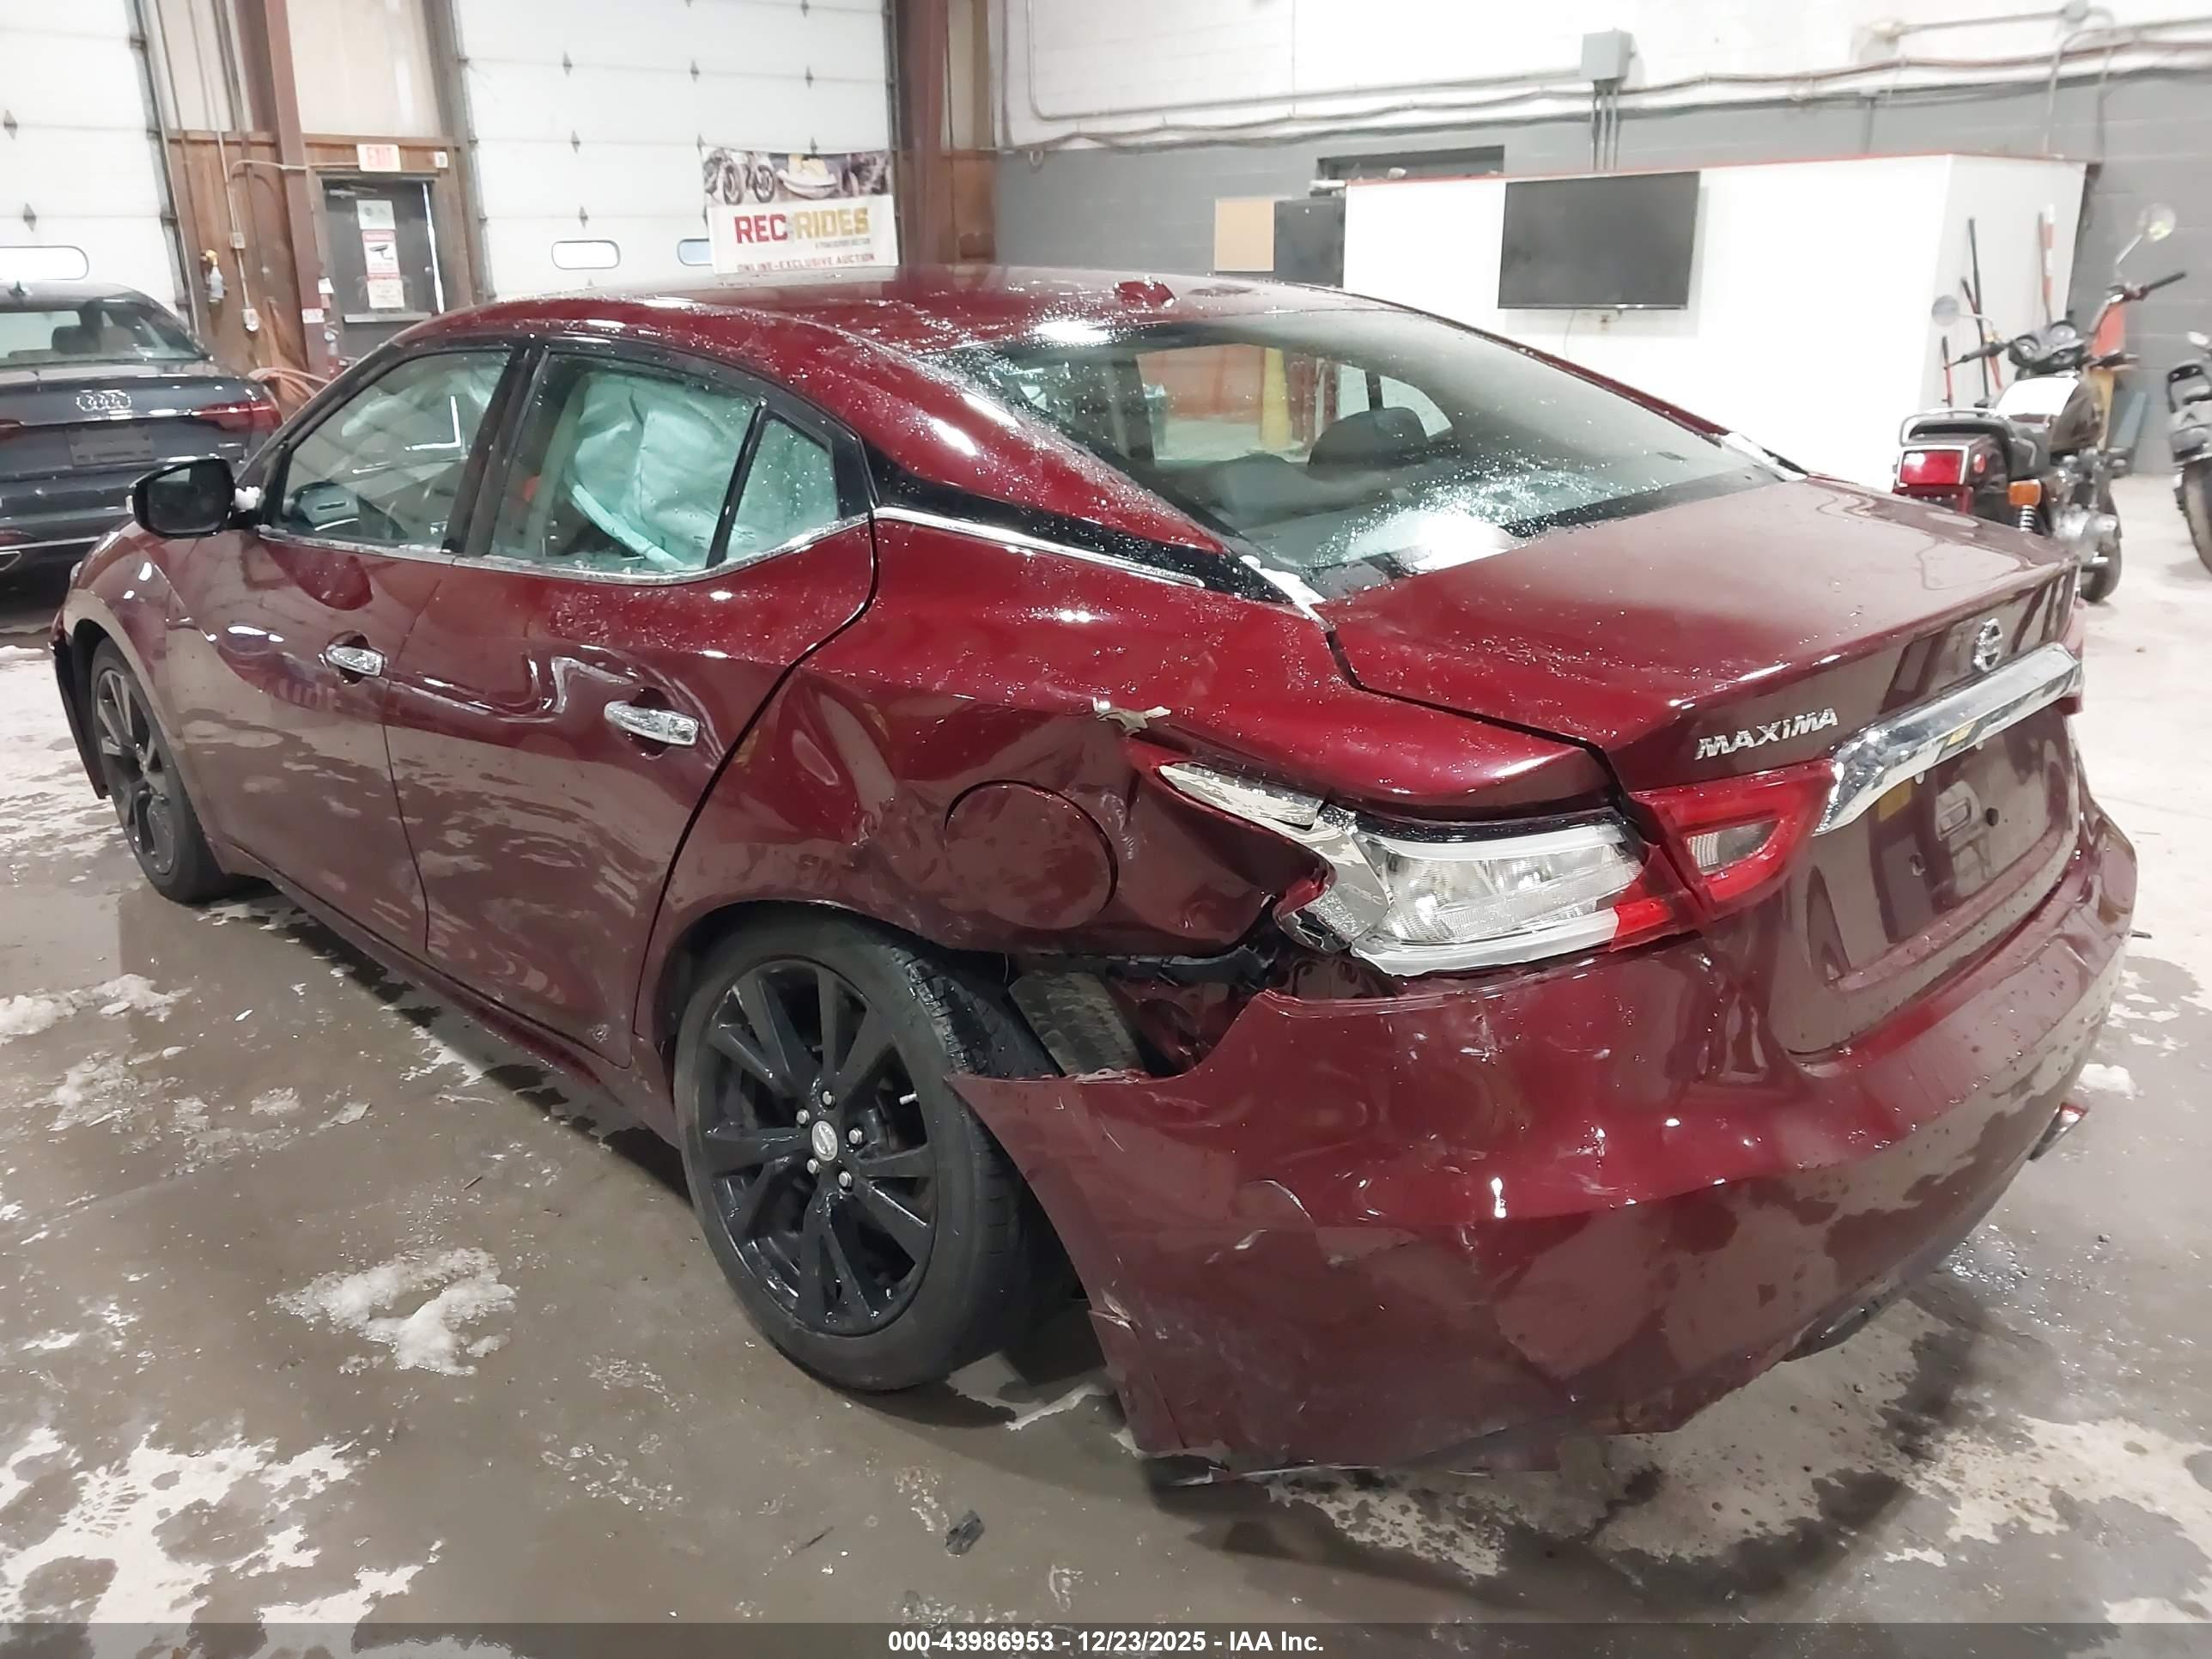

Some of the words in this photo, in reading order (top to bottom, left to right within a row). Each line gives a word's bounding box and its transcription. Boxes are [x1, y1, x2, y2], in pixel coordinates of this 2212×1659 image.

[366, 146, 392, 167] EXIT
[734, 213, 788, 244] REC
[793, 206, 871, 240] RIDES
[835, 252, 876, 266] AUCTION
[1694, 708, 1839, 761] MAXIMA
